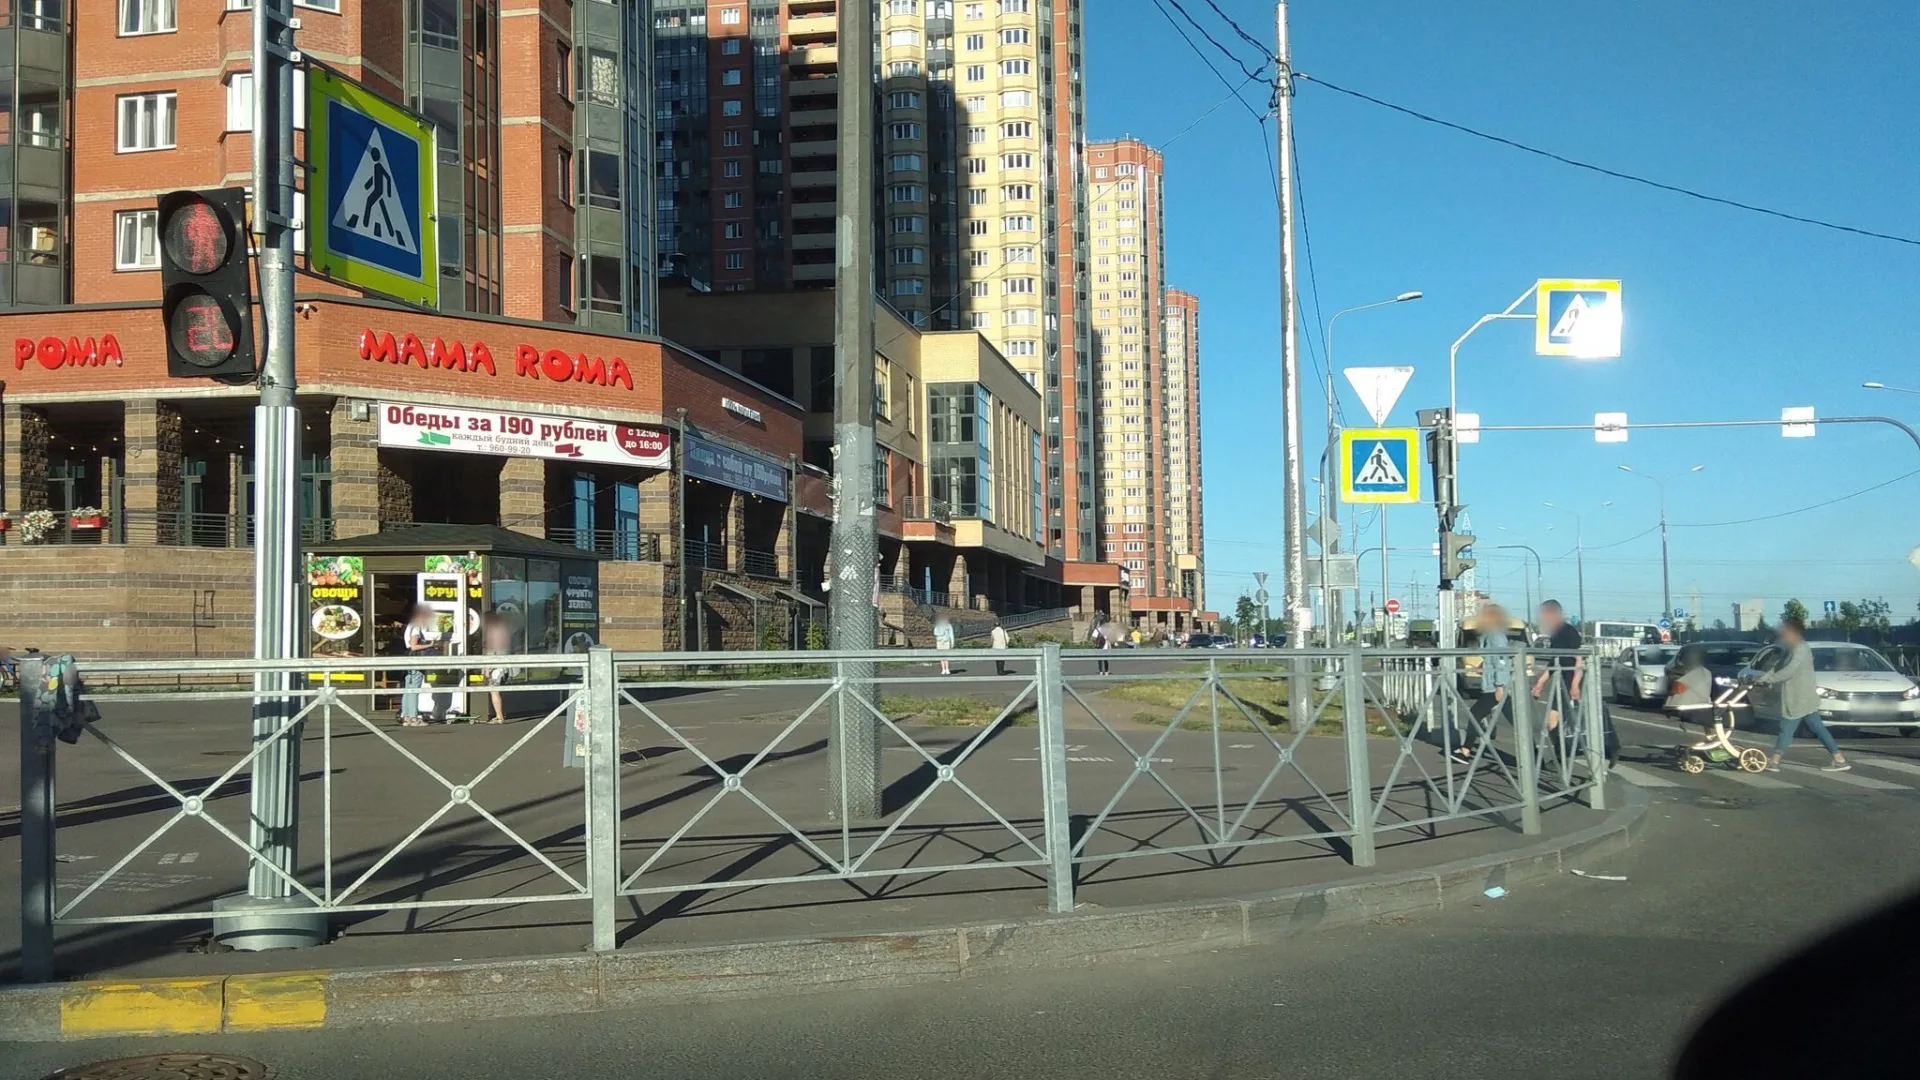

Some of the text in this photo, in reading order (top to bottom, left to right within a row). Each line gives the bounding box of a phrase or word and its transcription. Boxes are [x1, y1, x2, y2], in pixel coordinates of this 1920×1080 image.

[15, 333, 123, 370] РОМА
[359, 327, 634, 391] MAMA ROMA
[387, 405, 608, 442] Обеды за 190 рублей
[636, 427, 660, 439] 12:00
[452, 433, 554, 448] каждый будний день
[625, 440, 663, 451] до 16:00
[489, 443, 531, 455] 960-99-20
[312, 587, 359, 601] ОВОЩИ
